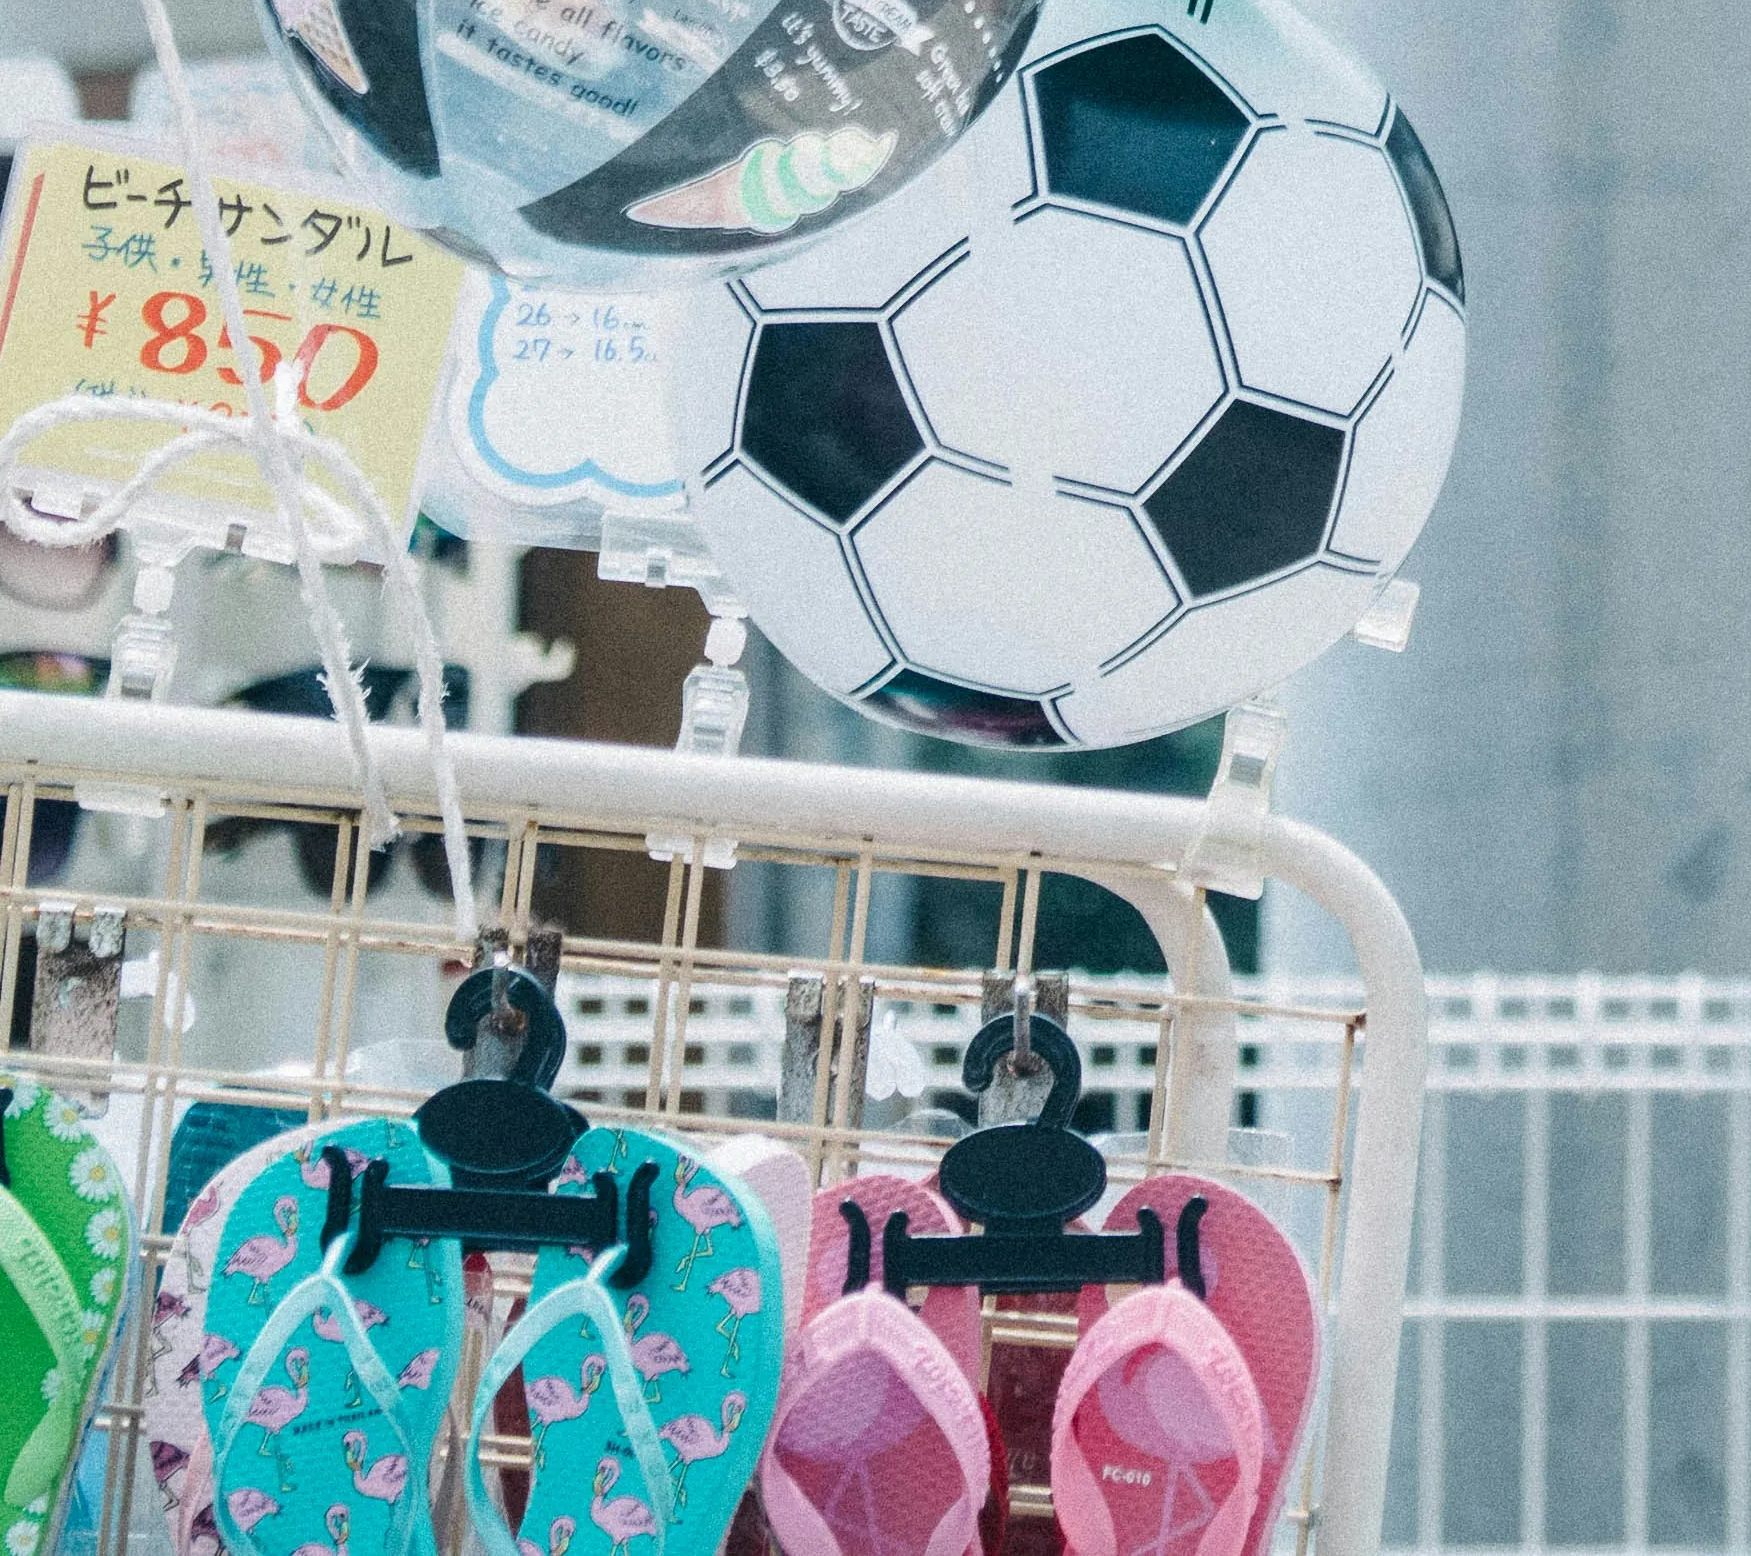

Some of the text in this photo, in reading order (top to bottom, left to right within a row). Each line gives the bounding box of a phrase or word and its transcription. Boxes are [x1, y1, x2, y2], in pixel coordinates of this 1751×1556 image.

[513, 17, 587, 67] candy
[558, 4, 596, 30] all
[599, 18, 689, 73] flavors
[840, 2, 889, 43] TASTE
[483, 36, 564, 89] tastes
[570, 79, 640, 118] good!
[82, 164, 414, 268] ビーチサンダル
[515, 302, 552, 328] 26
[512, 338, 552, 362] 27
